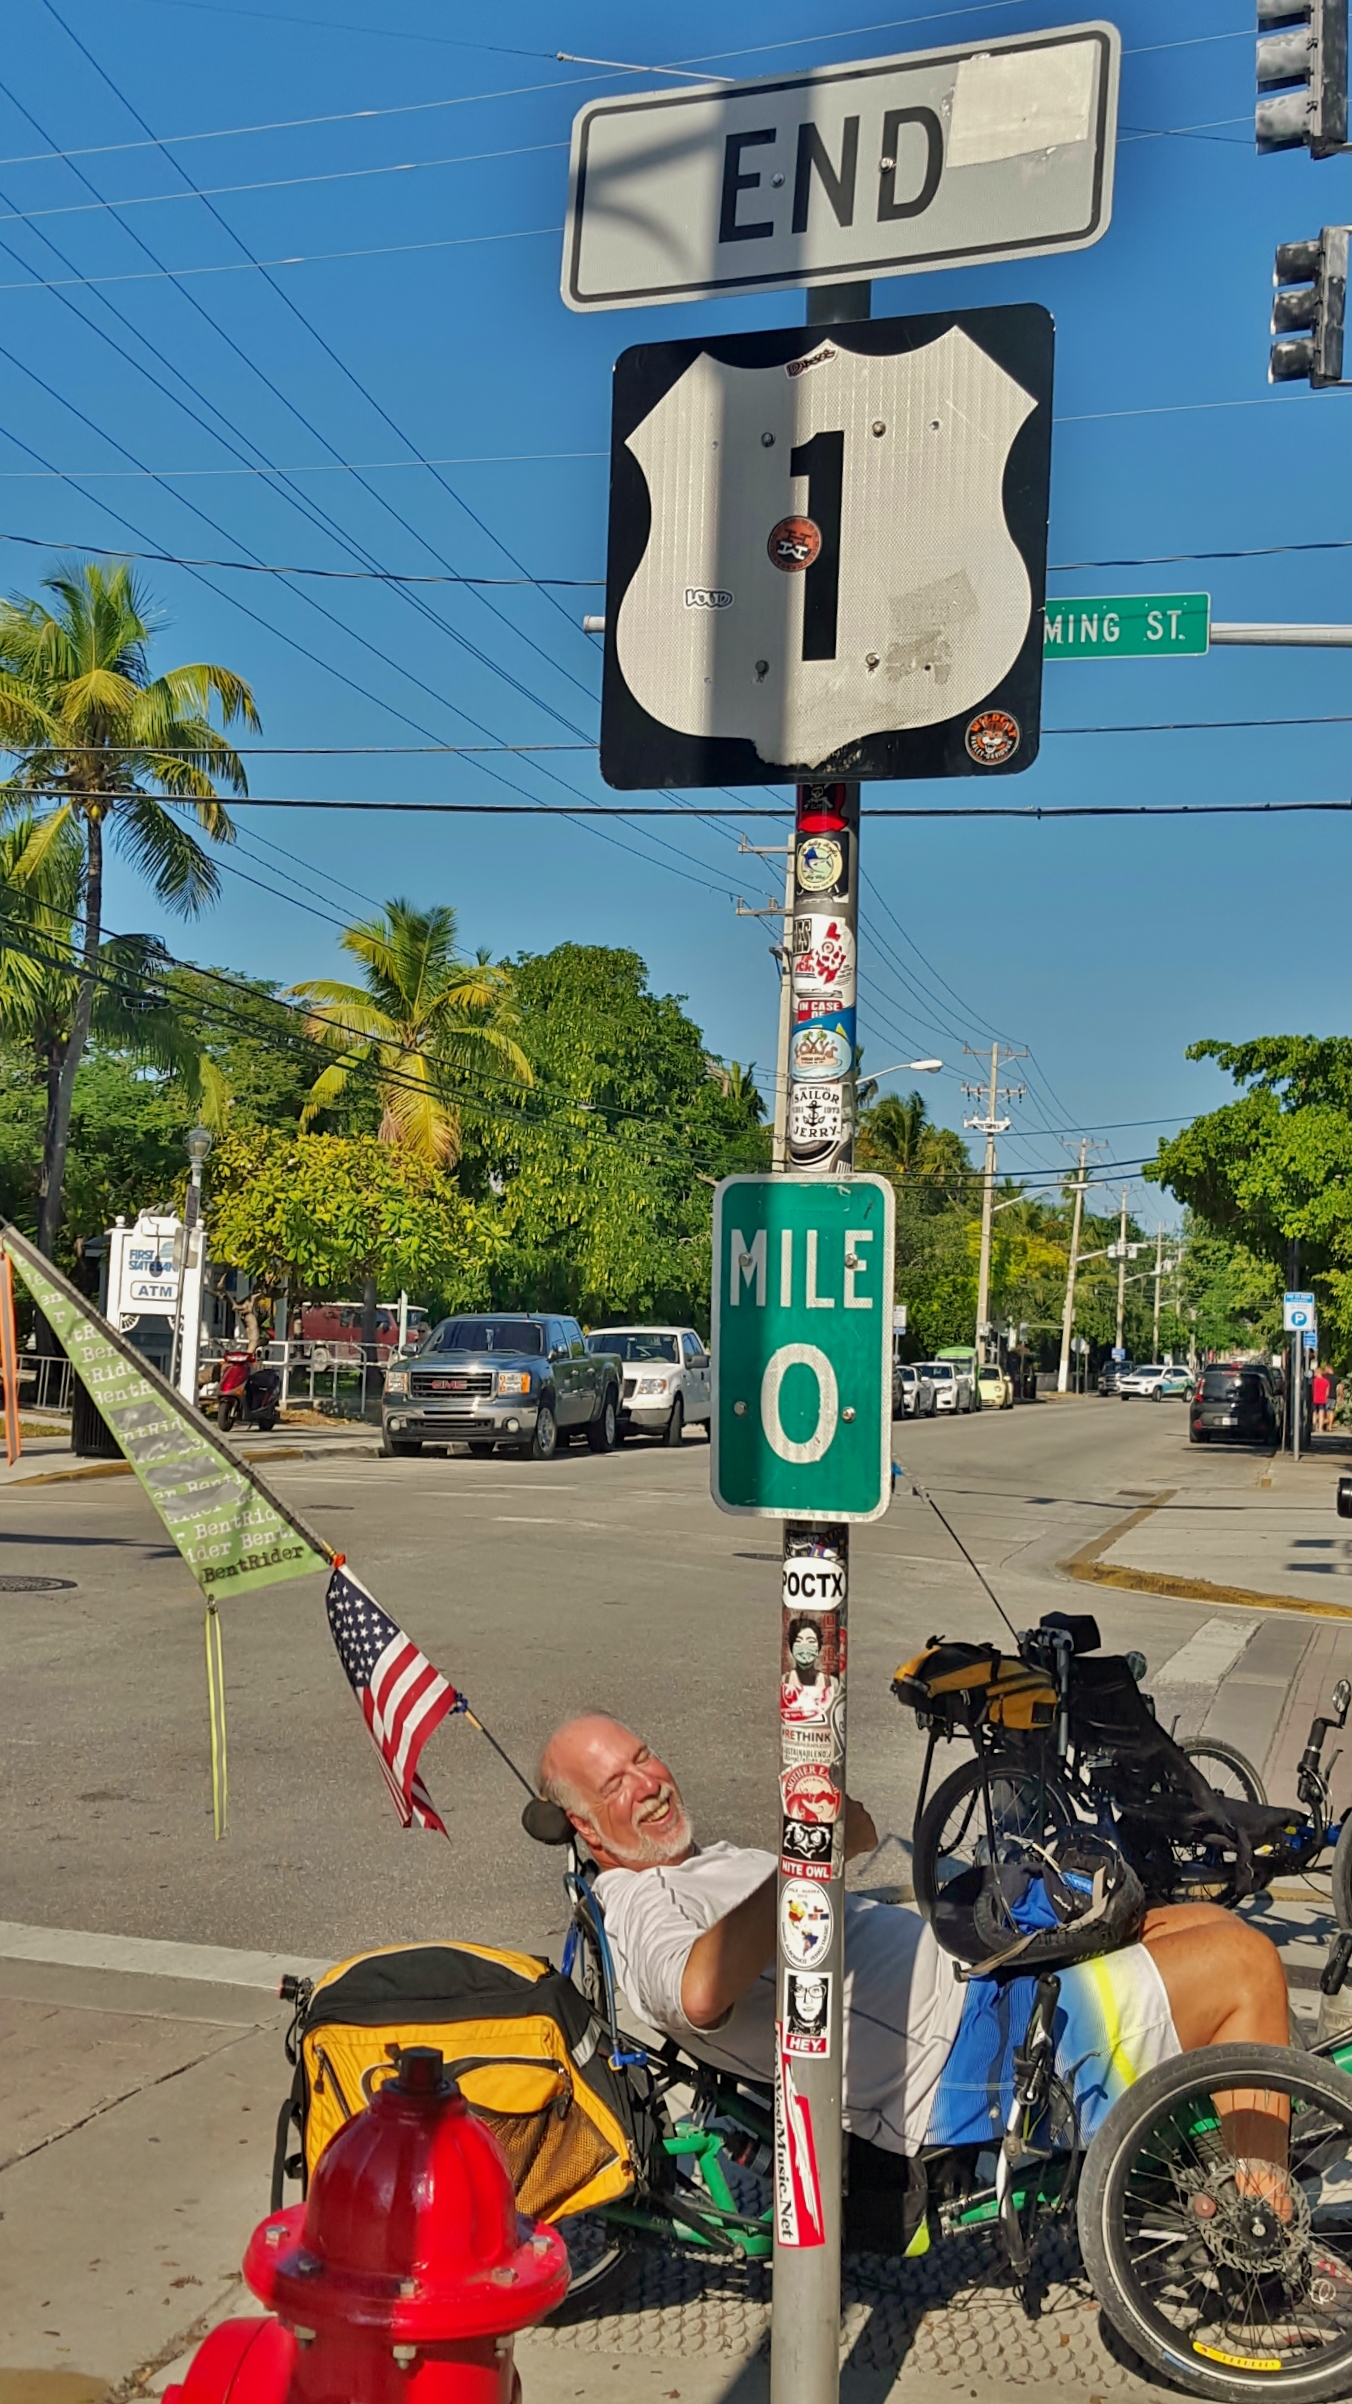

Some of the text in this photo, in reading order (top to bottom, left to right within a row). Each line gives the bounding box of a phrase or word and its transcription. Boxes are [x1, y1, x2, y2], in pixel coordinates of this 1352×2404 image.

[718, 105, 943, 243] END
[790, 430, 845, 661] 1
[799, 1001, 840, 1011] IN CASE
[794, 1091, 840, 1104] SAILOR
[793, 1125, 838, 1138] JERRY
[129, 1249, 155, 1260] FIRST
[729, 1229, 874, 1309] MILE
[138, 1285, 173, 1297] ATM
[432, 1380, 468, 1390] GMC
[760, 1342, 839, 1464] 0
[202, 1545, 304, 1583] BentRider
[786, 1765, 816, 1792] MOTHER
[782, 1859, 830, 1879] NITE OWL
[789, 2036, 822, 2051] HEY.
